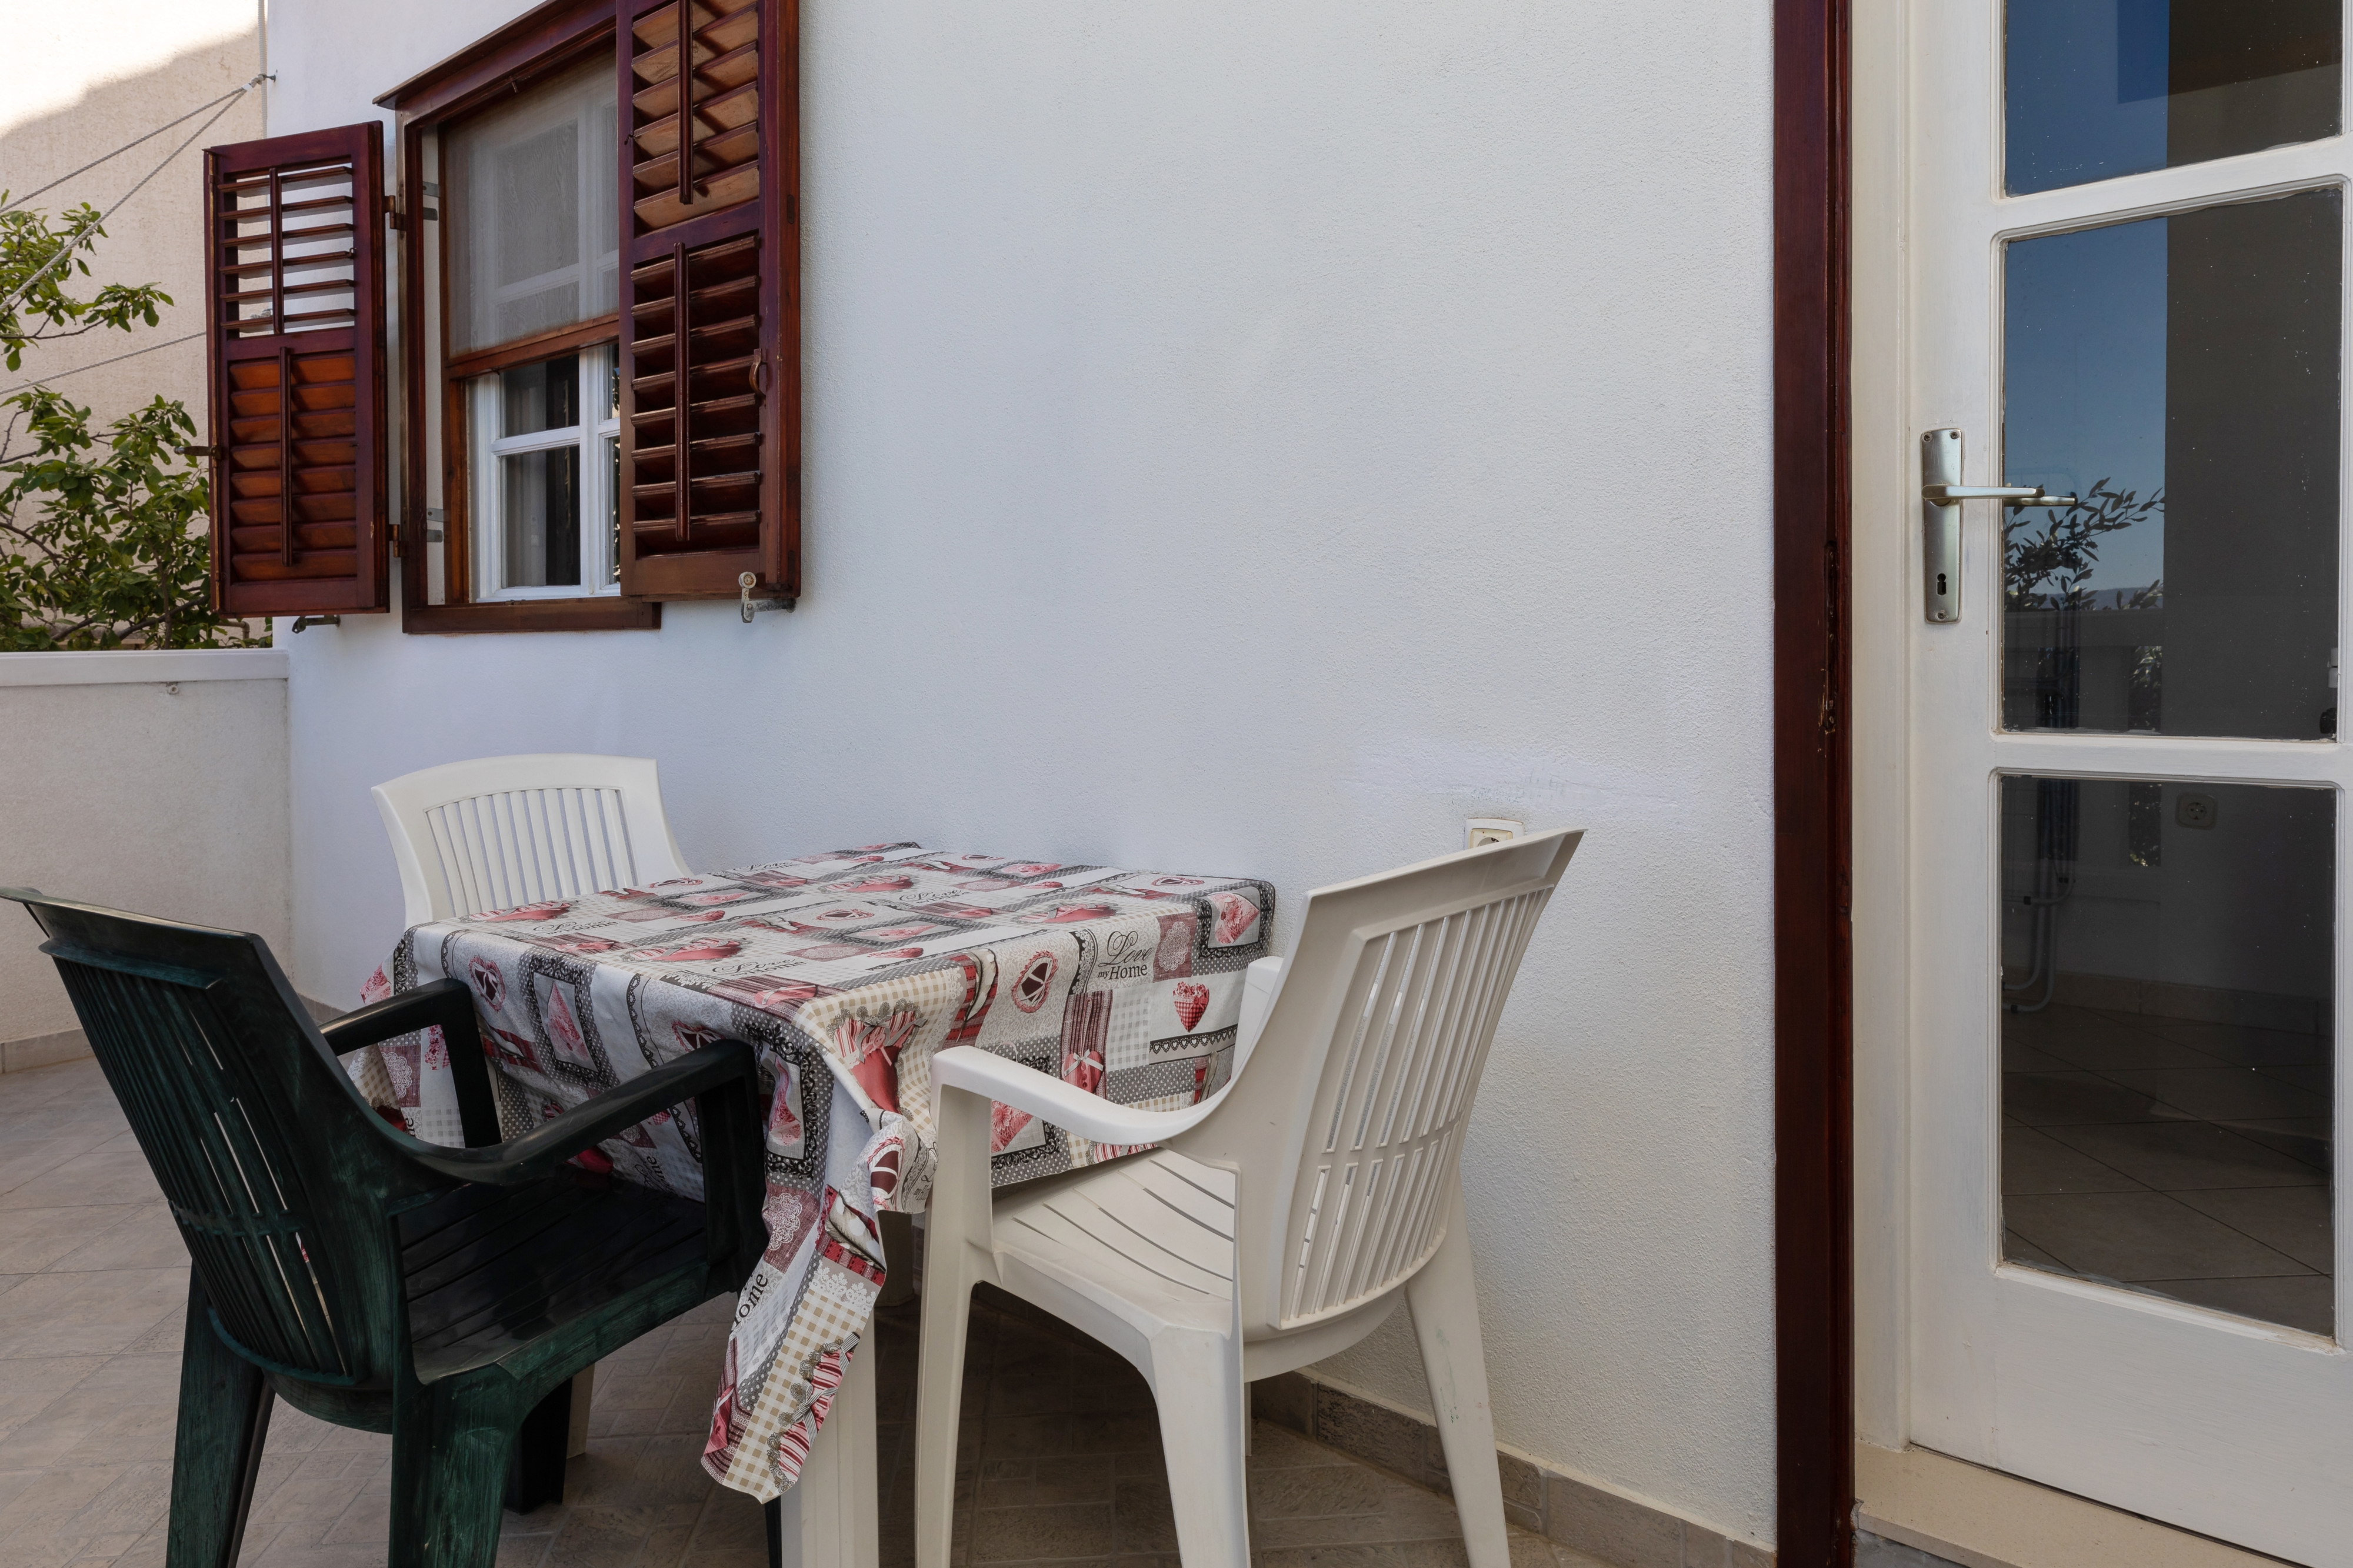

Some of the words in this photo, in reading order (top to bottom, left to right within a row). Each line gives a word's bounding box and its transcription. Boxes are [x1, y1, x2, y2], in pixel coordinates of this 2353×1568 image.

[1098, 930, 1152, 968] Love
[1097, 970, 1110, 979] my
[1108, 964, 1148, 980] Home
